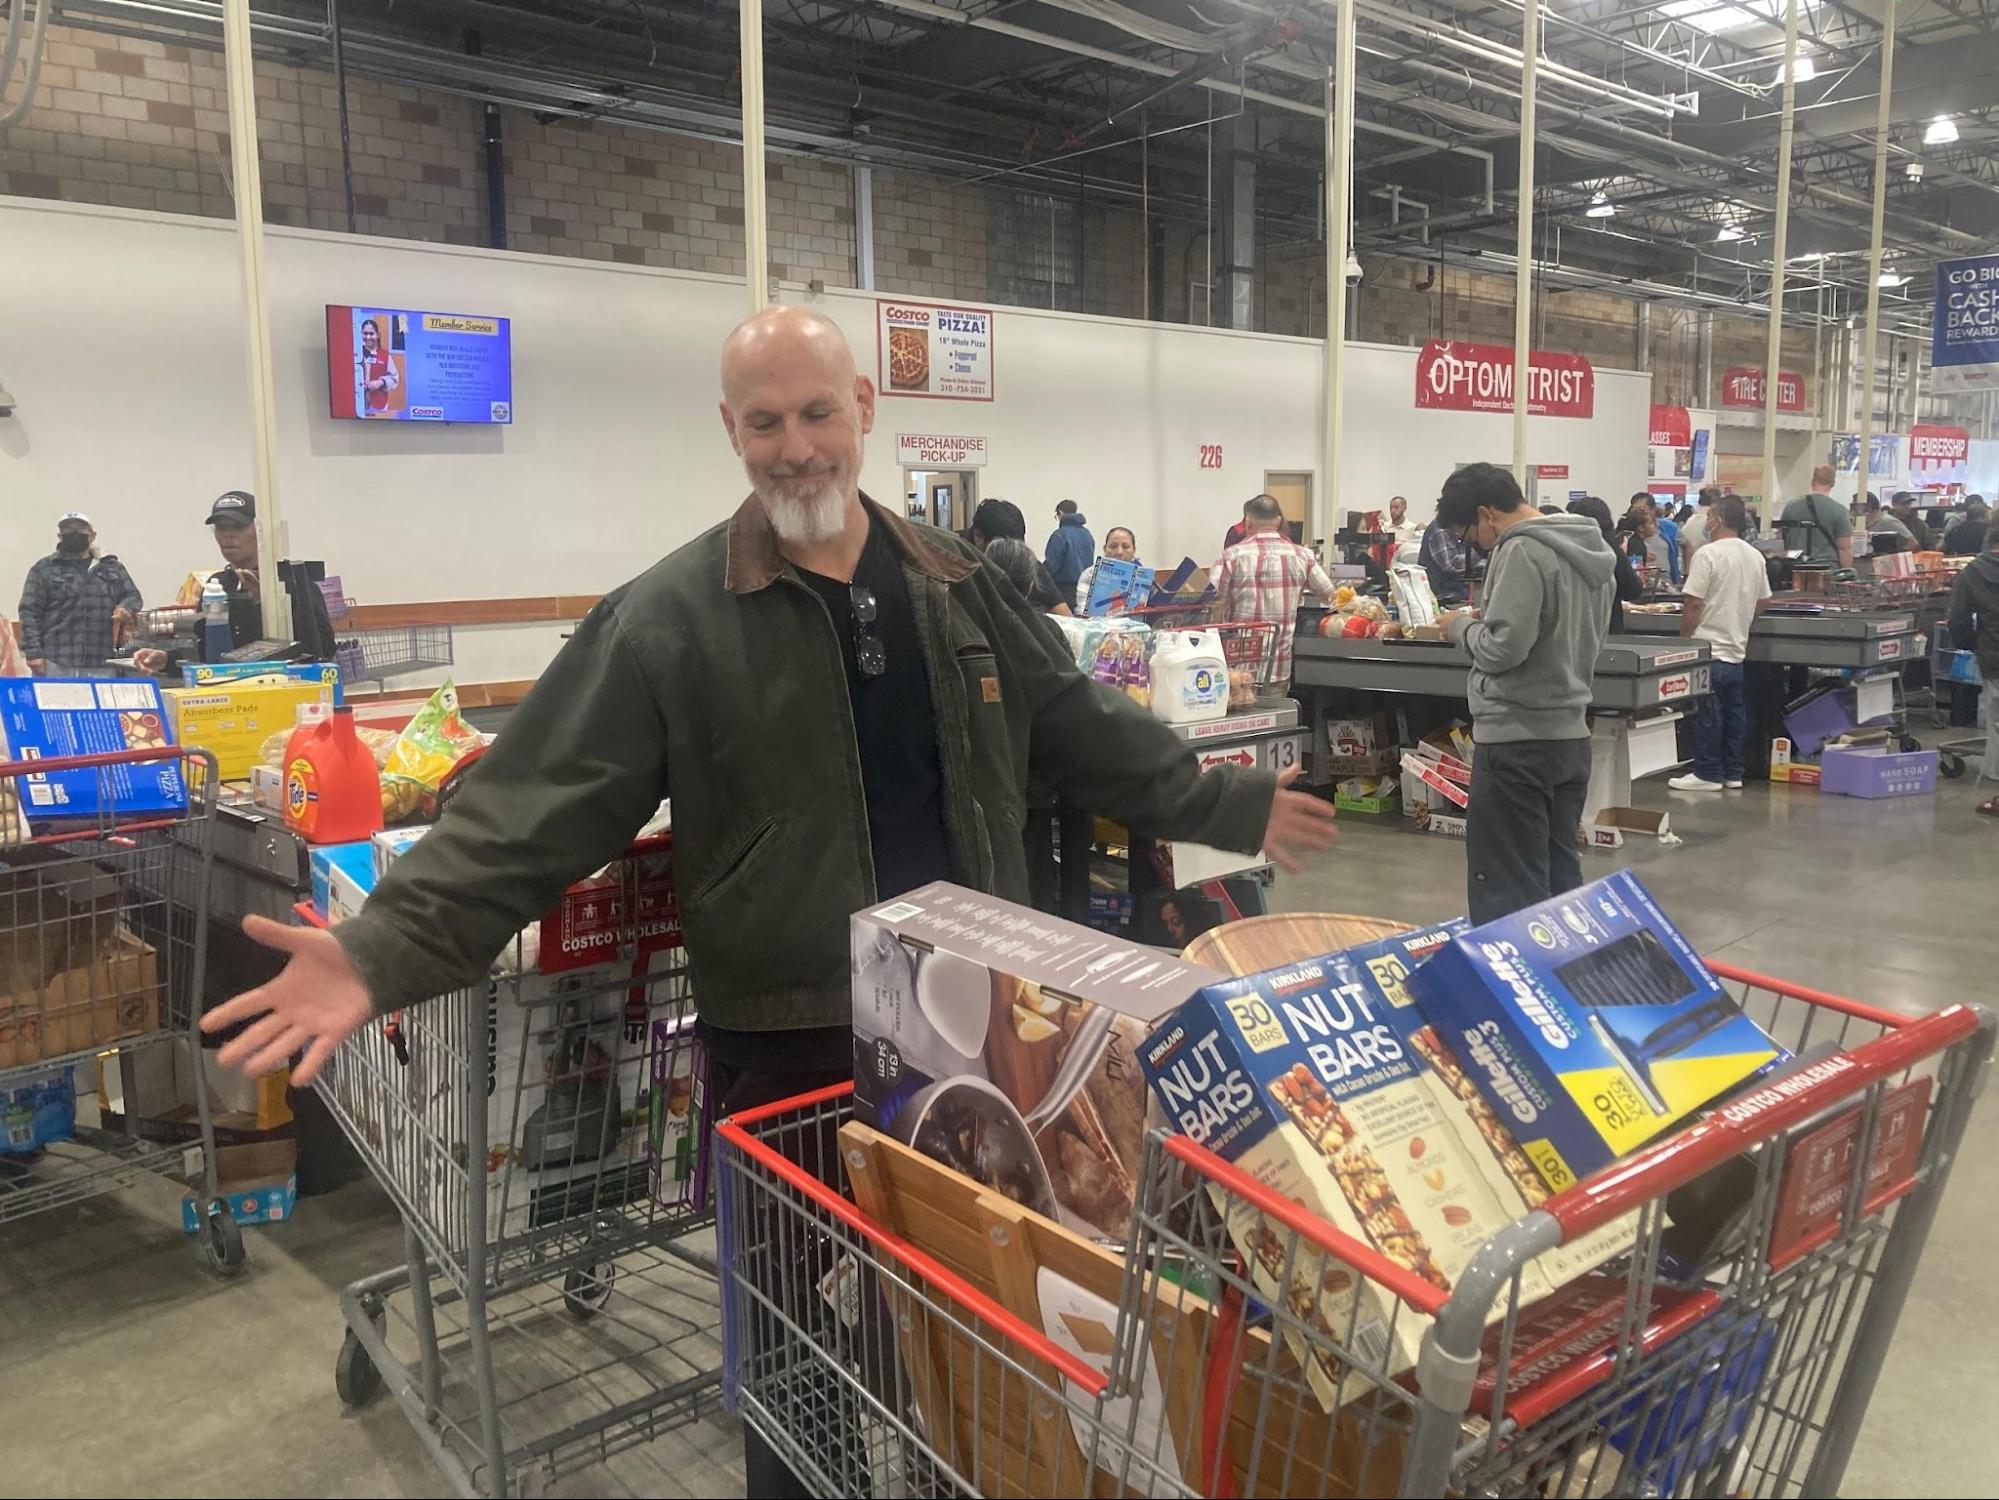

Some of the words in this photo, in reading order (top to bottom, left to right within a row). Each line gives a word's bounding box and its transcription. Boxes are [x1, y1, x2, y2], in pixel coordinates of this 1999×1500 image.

[1949, 269, 1976, 284] GO
[430, 318, 463, 330] Member
[465, 320, 492, 332] Service
[886, 307, 930, 321] COSTCO
[938, 311, 951, 319] TASTE
[938, 318, 985, 333] PIZZA!
[1946, 326, 1999, 339] REWARD
[970, 339, 986, 347] Pizza
[1430, 357, 1584, 403] OPTOMTRIST
[1760, 380, 1796, 403] CTER
[901, 436, 984, 450] MERCHANDISE
[1913, 437, 1965, 457] MEMBERSHIP
[921, 450, 966, 462] PICK-UP
[1200, 444, 1222, 468] 226
[196, 668, 213, 679] 90
[1196, 676, 1208, 689] all
[1695, 669, 1708, 689] 12
[183, 705, 234, 717] Absorbent
[236, 704, 259, 713] Pads
[1195, 725, 1212, 736] LEAVE
[1270, 741, 1294, 769] 13
[1881, 768, 1901, 778] HAND
[1903, 765, 1929, 777] SOAP
[160, 770, 173, 799] PIZZA
[289, 781, 304, 806] Tide
[562, 932, 614, 953] COSTCO
[1402, 931, 1451, 951] KIRKLAND
[1269, 967, 1323, 990] KIRKLAND
[1373, 961, 1408, 988] 30
[1510, 957, 1536, 986] PLUS
[1482, 942, 1570, 1049] Gillette
[1233, 1000, 1272, 1031] 30
[1281, 983, 1375, 1043] NUT
[1535, 987, 1577, 1040] CUSTOM
[1148, 1027, 1185, 1064] KIRKLAND
[1250, 1028, 1282, 1047] BARS
[878, 1041, 886, 1058] 34
[890, 1054, 898, 1066] 13
[1307, 1025, 1403, 1083] BARS
[878, 1059, 885, 1077] cm
[889, 1067, 898, 1077] in
[1158, 1029, 1227, 1113] NUT
[1463, 1028, 1537, 1123] Gillette
[1511, 1063, 1547, 1110] CUSTOM
[1723, 1089, 1779, 1122] COSTCO
[1775, 1056, 1856, 1096] WHOLESALE
[1179, 1070, 1253, 1144] BARS
[1593, 1094, 1624, 1130] 30
[1407, 1152, 1446, 1175] ALMONDS
[1545, 1155, 1568, 1185] 30
